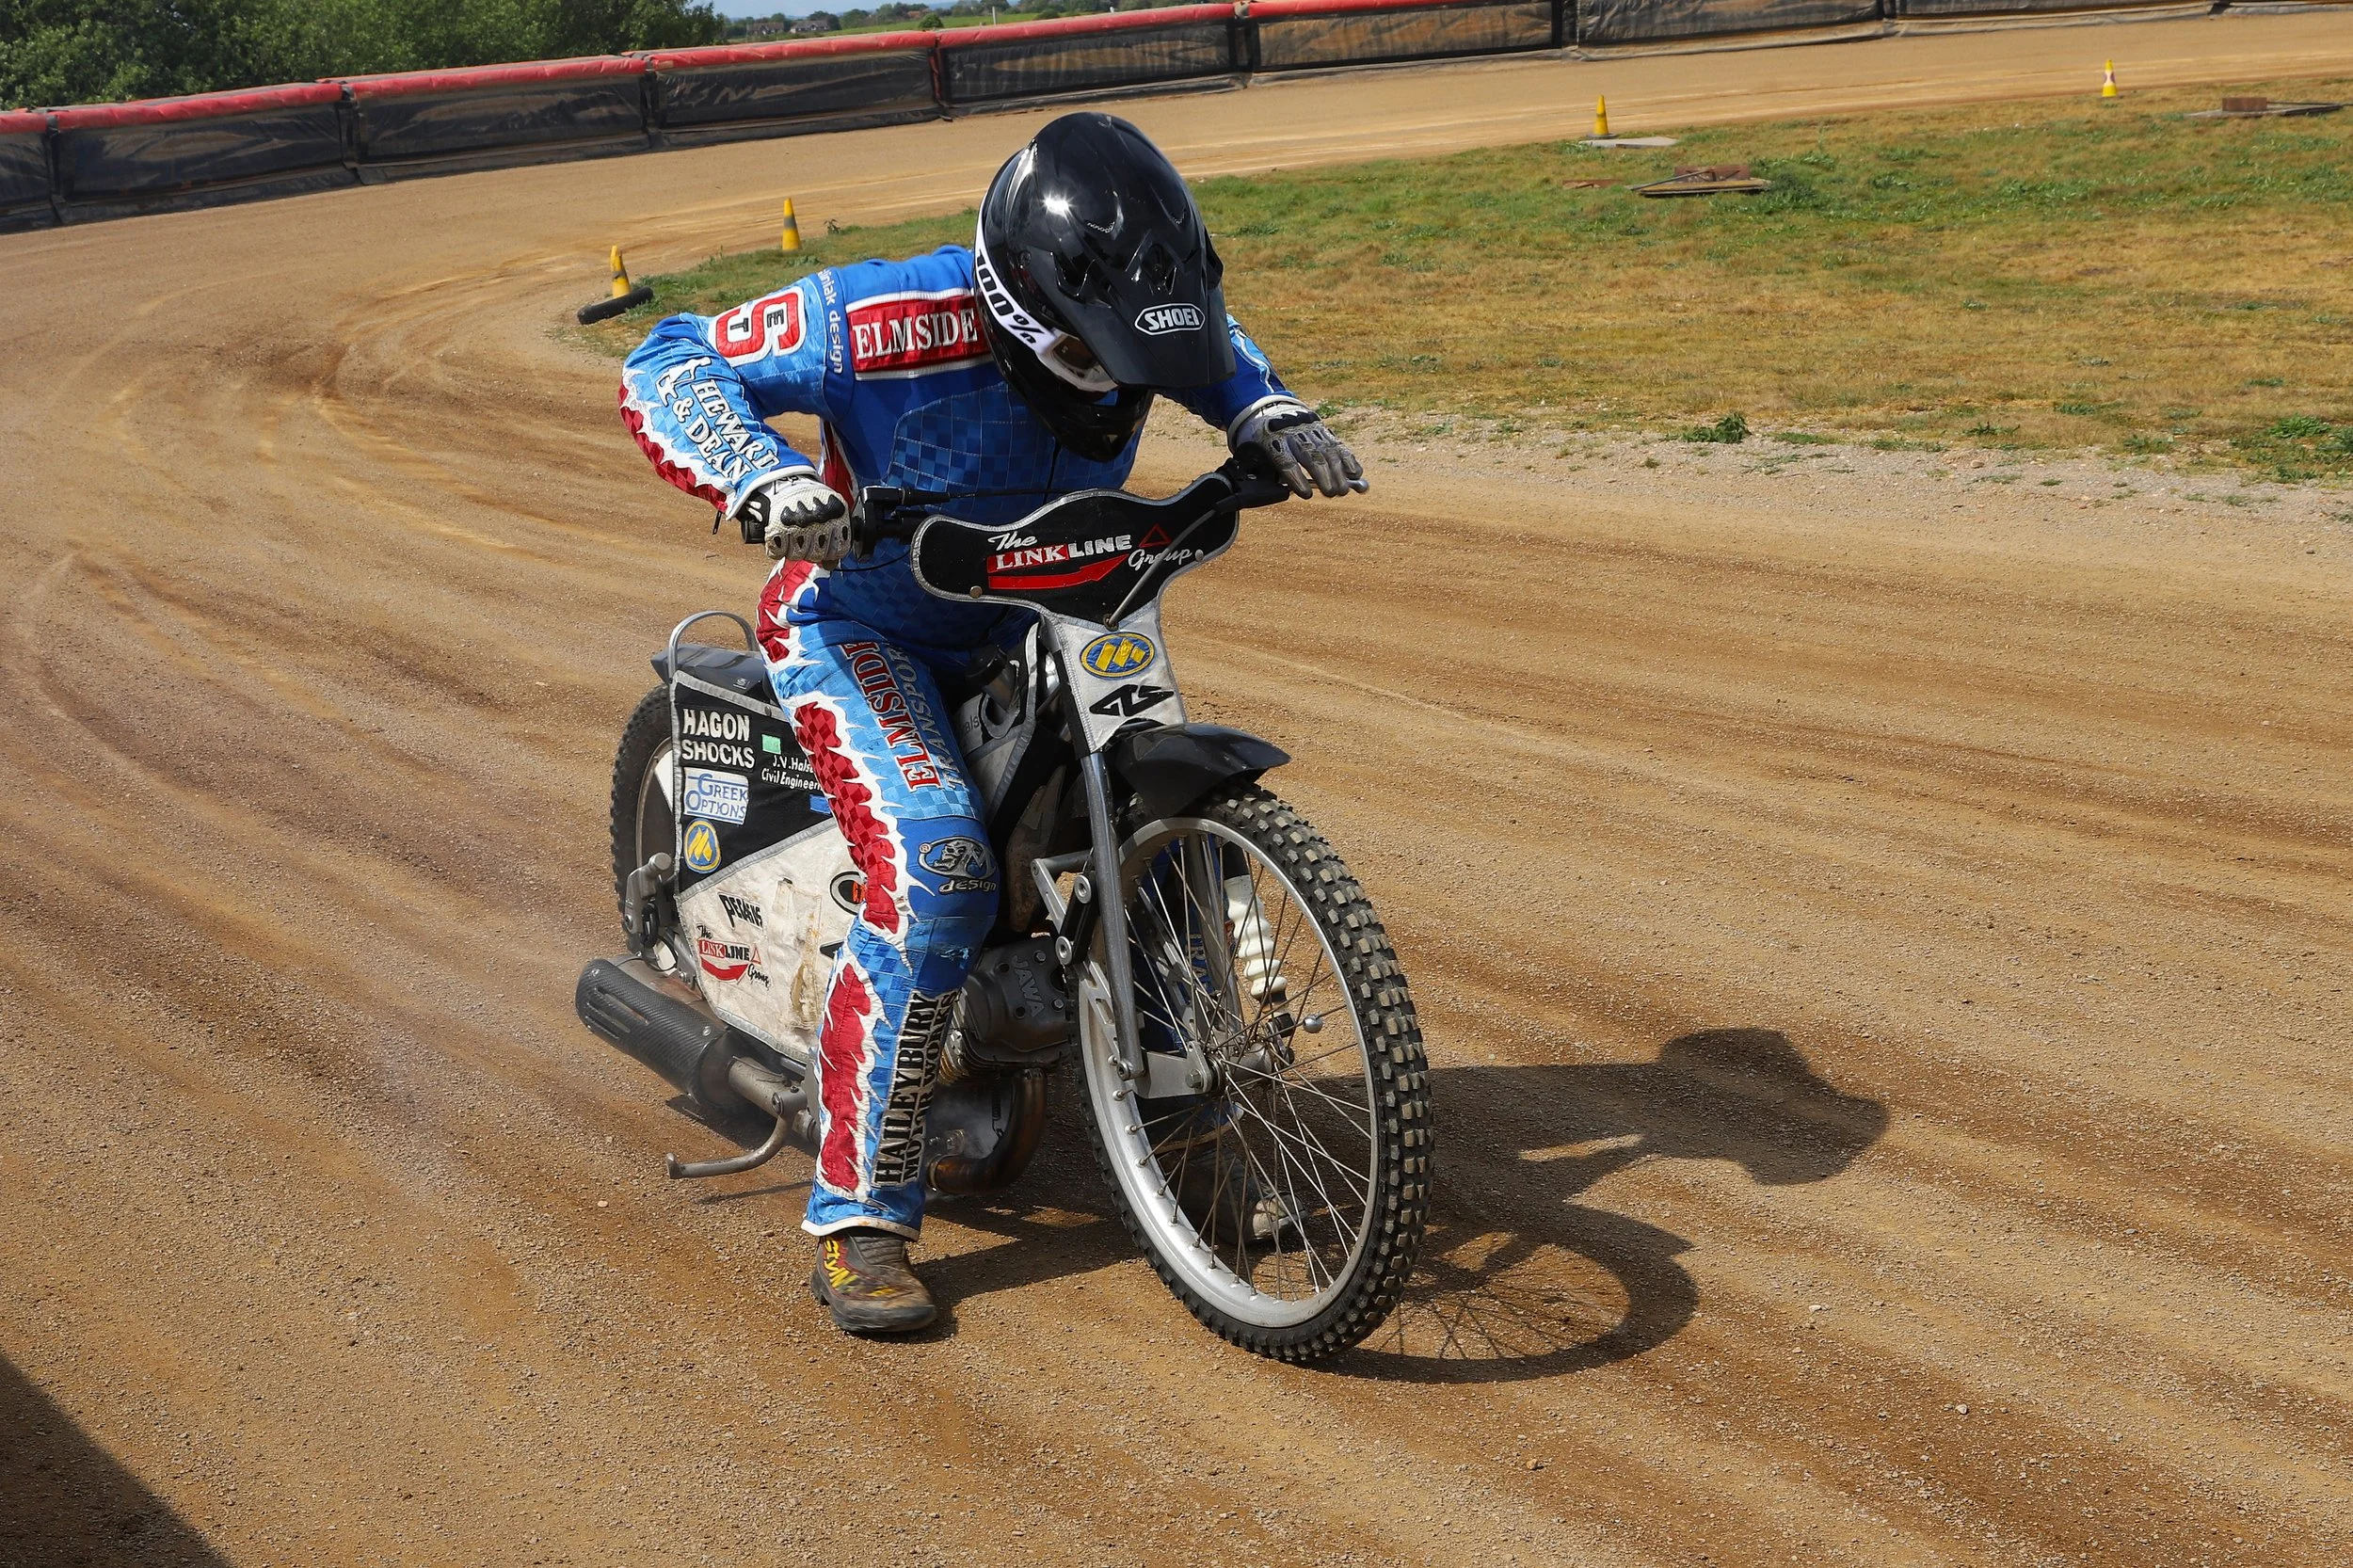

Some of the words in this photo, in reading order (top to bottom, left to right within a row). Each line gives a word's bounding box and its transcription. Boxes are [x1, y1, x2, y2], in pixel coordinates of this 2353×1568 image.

[852, 307, 979, 361] ELMSIDE
[1144, 308, 1200, 331] SHOEI
[828, 311, 844, 375] design
[671, 395, 695, 424] &
[684, 414, 753, 480] DEAN
[690, 378, 780, 471] HEWARD
[987, 530, 1038, 552] The
[682, 708, 751, 742] HAGON
[680, 739, 756, 769] SHOCKS
[761, 768, 780, 785] Civil
[938, 878, 998, 894] design
[696, 924, 712, 940] The
[1011, 953, 1045, 1017] JAWA
[874, 991, 939, 1184] HAILEYBURY
